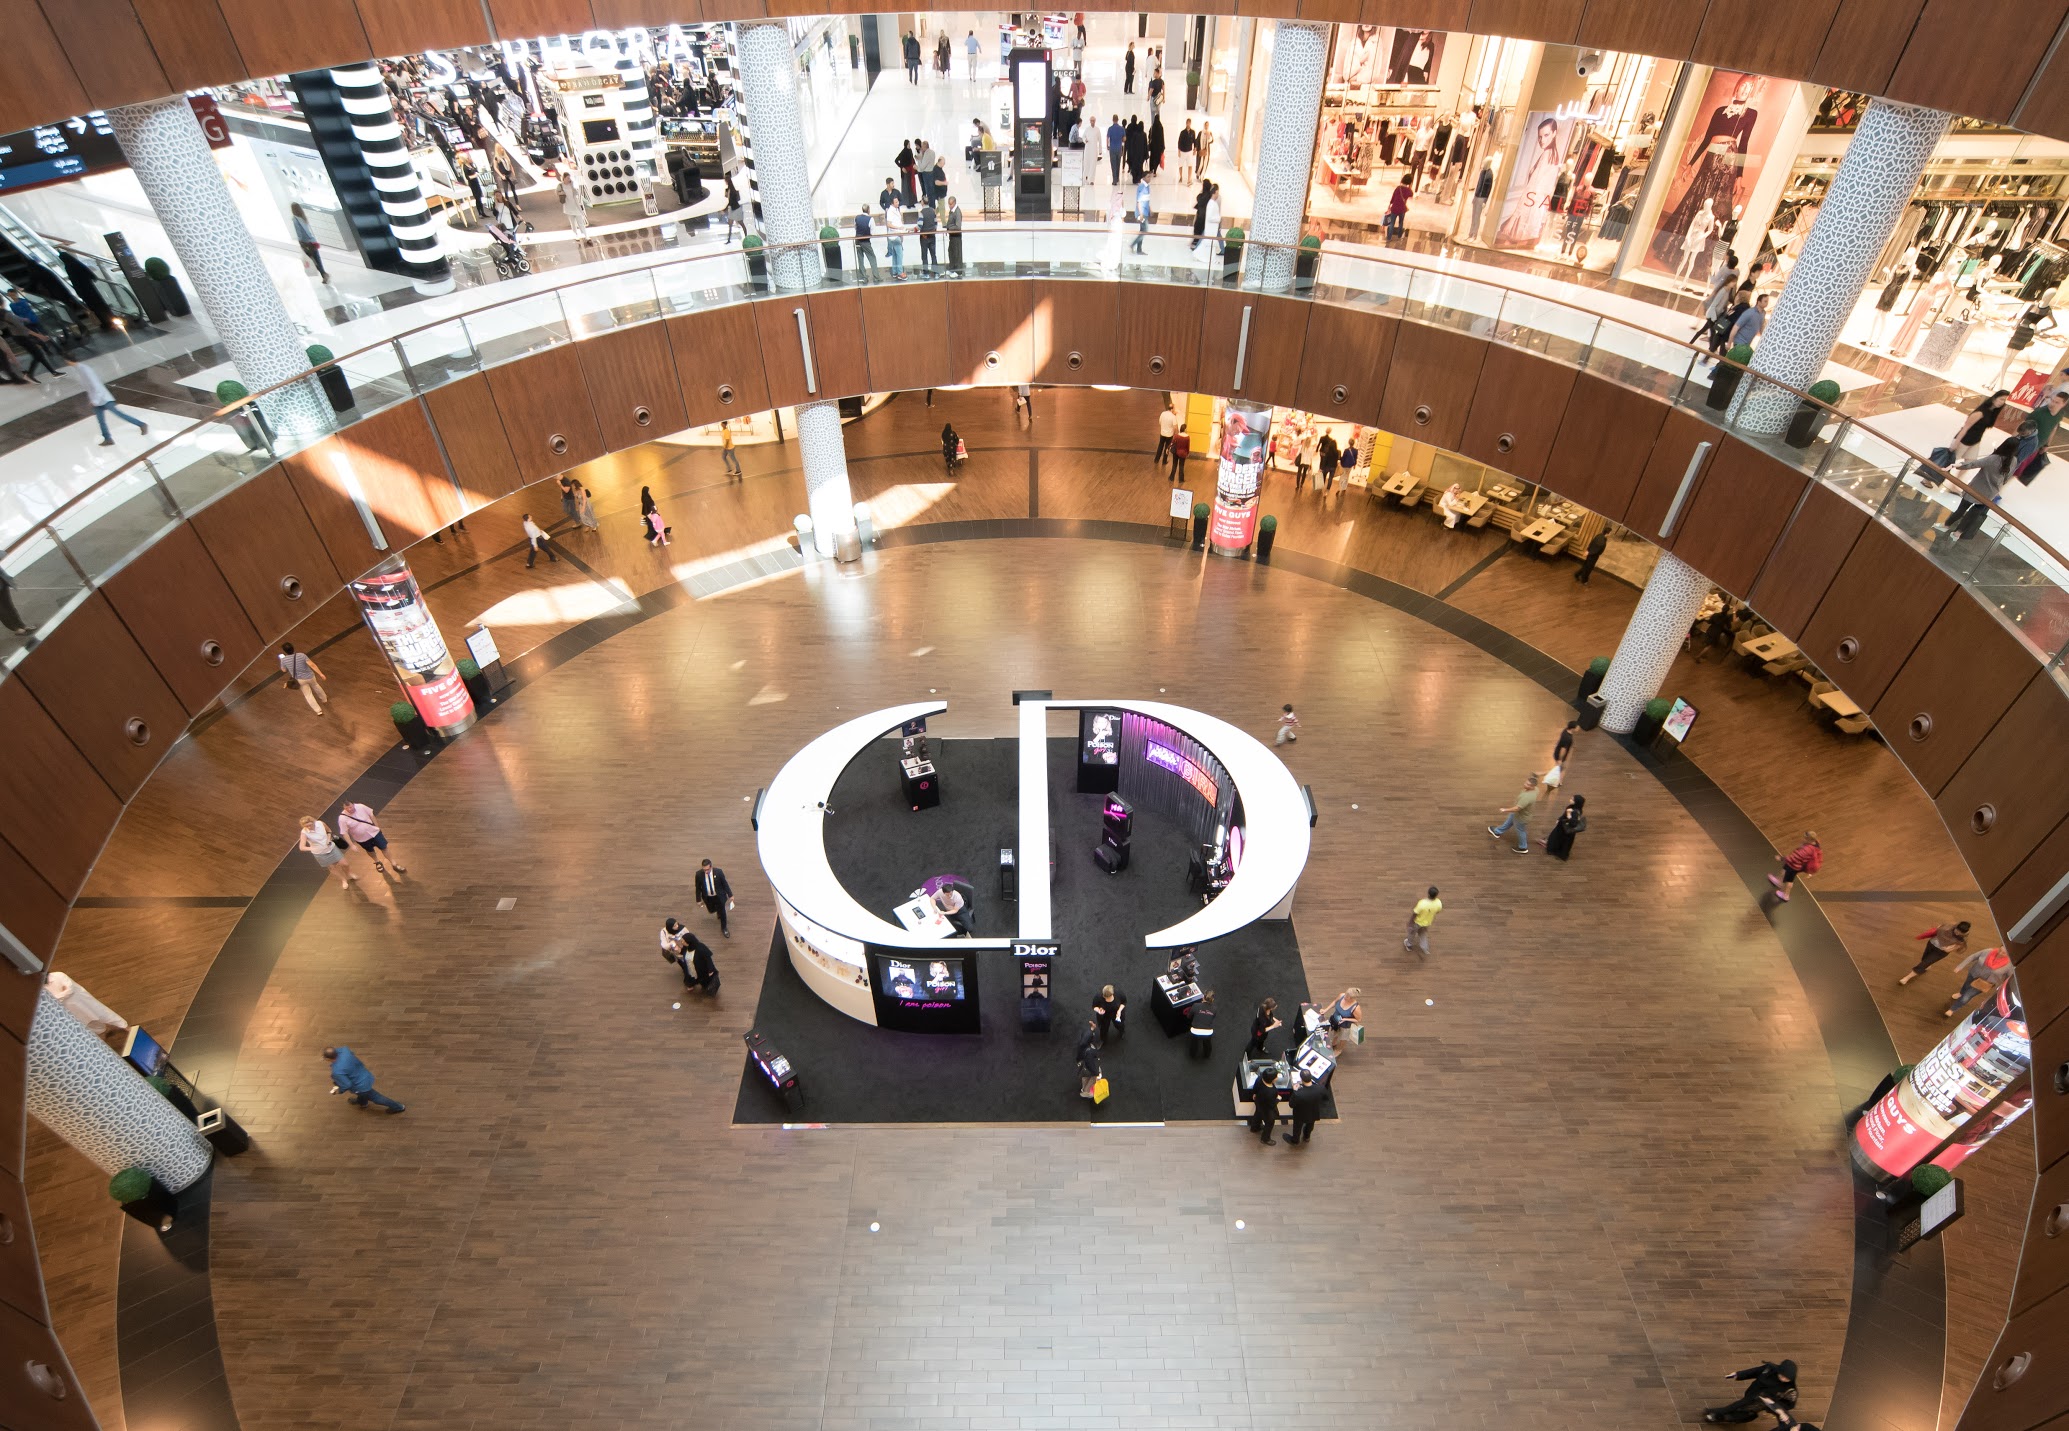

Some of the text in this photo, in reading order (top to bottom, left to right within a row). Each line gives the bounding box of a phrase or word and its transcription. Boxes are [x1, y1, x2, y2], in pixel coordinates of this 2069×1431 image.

[201, 115, 225, 142] G
[1524, 191, 1590, 217] SALE
[1214, 504, 1227, 517] FIVE
[421, 683, 446, 695] FIVE
[1013, 944, 1058, 956] Dior
[890, 960, 911, 968] Dior
[921, 1001, 952, 1010] poison
[1937, 1042, 1977, 1089] BEST
[1887, 1096, 1917, 1135] GUYS
[1867, 1126, 1884, 1150] Fountain
